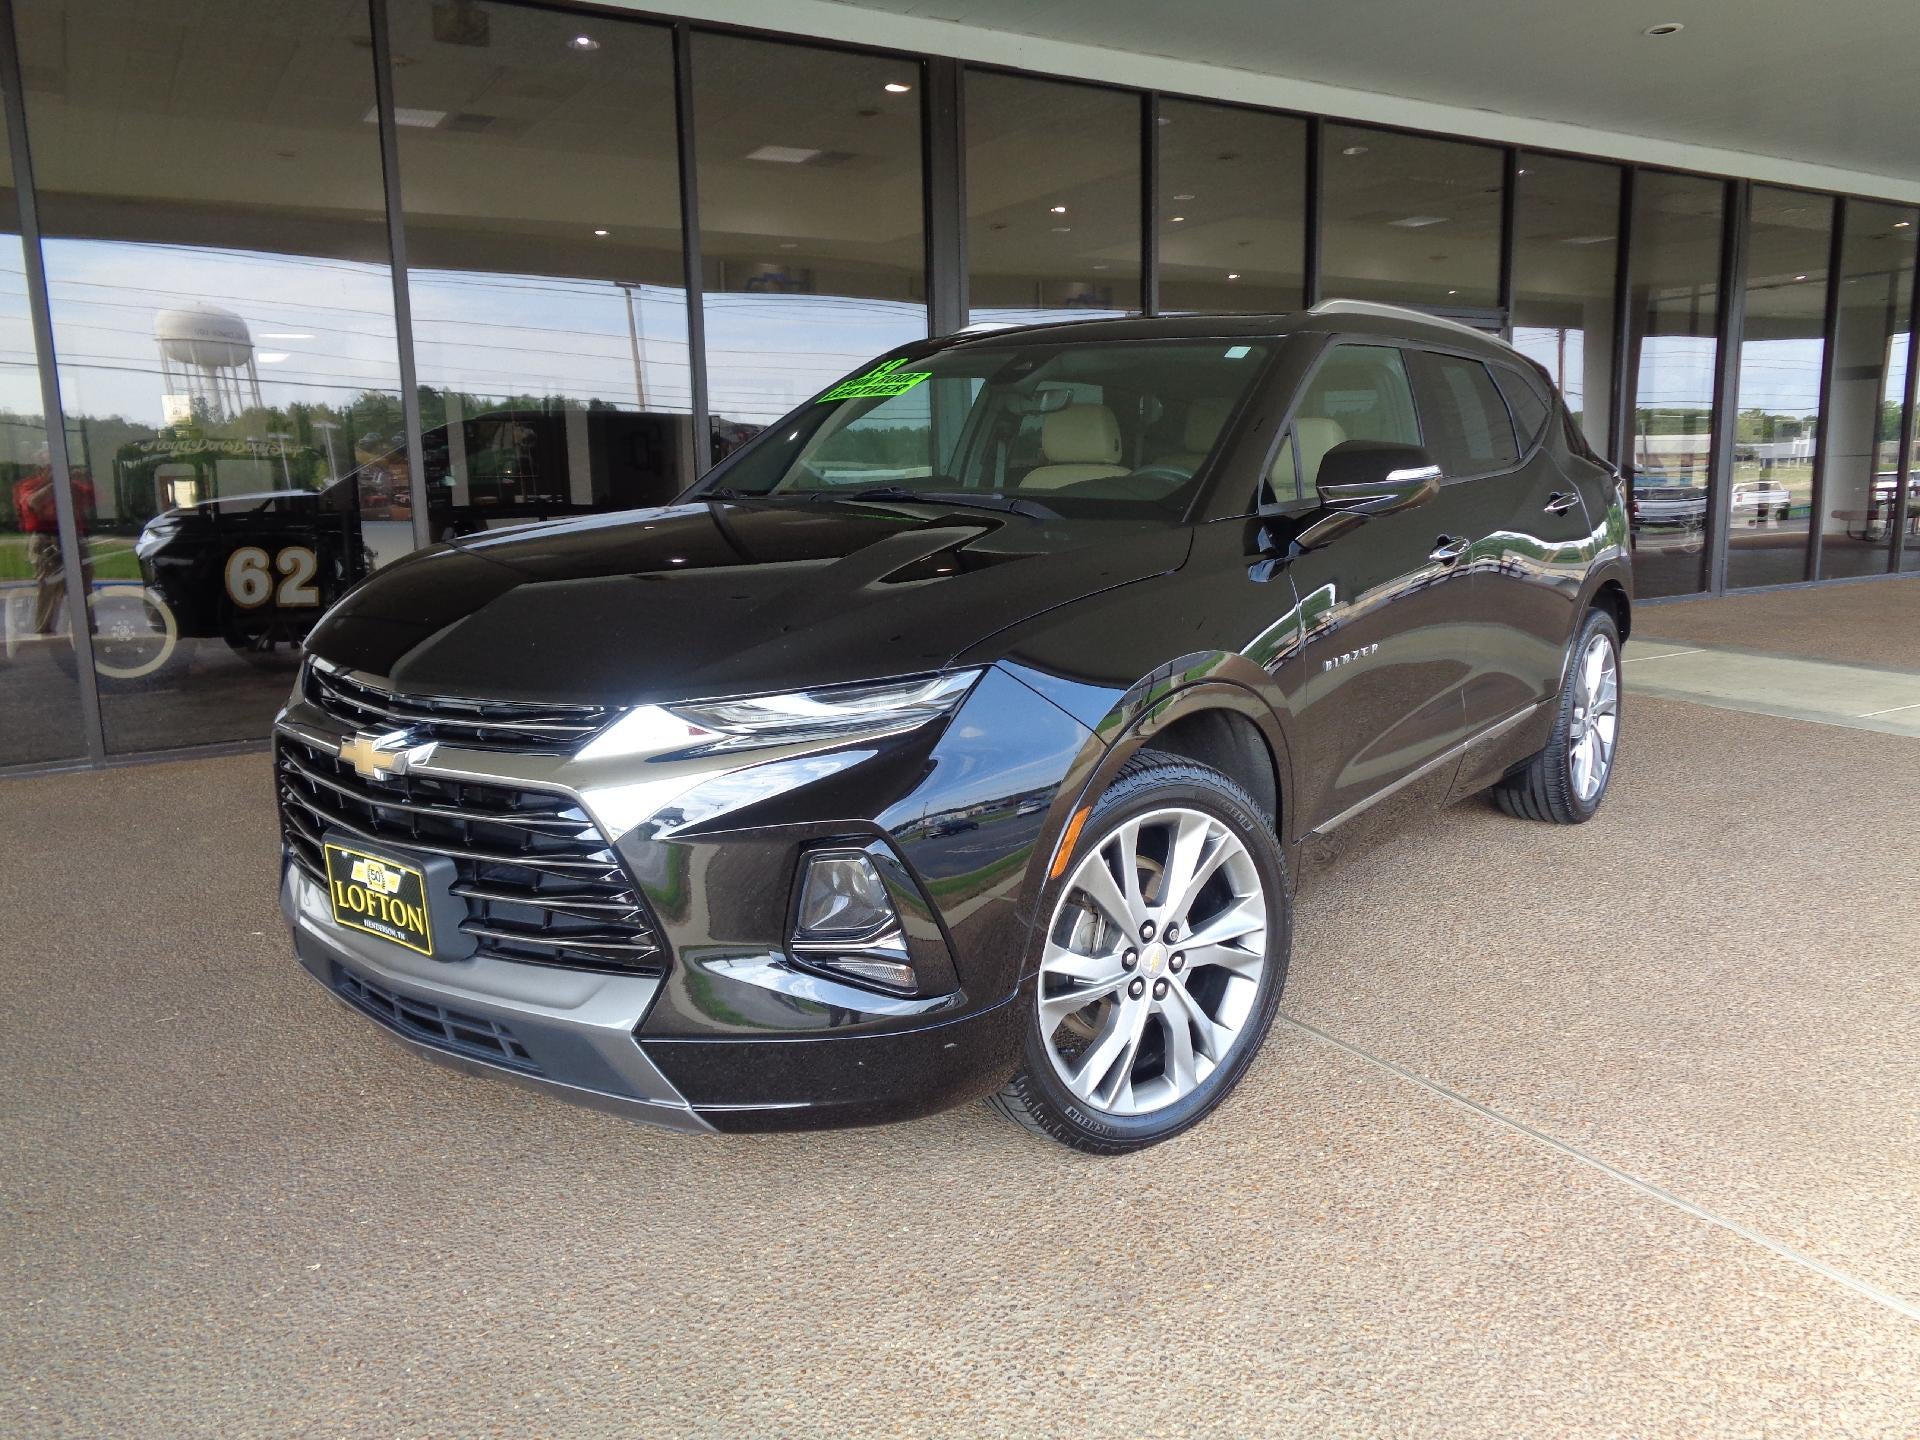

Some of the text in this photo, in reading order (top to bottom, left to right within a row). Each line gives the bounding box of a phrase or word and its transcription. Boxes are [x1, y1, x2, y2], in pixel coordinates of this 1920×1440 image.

[224, 546, 320, 608] 62
[1323, 643, 1379, 671] BLAZER
[370, 868, 381, 882] 50
[335, 880, 424, 935] LOFTON
